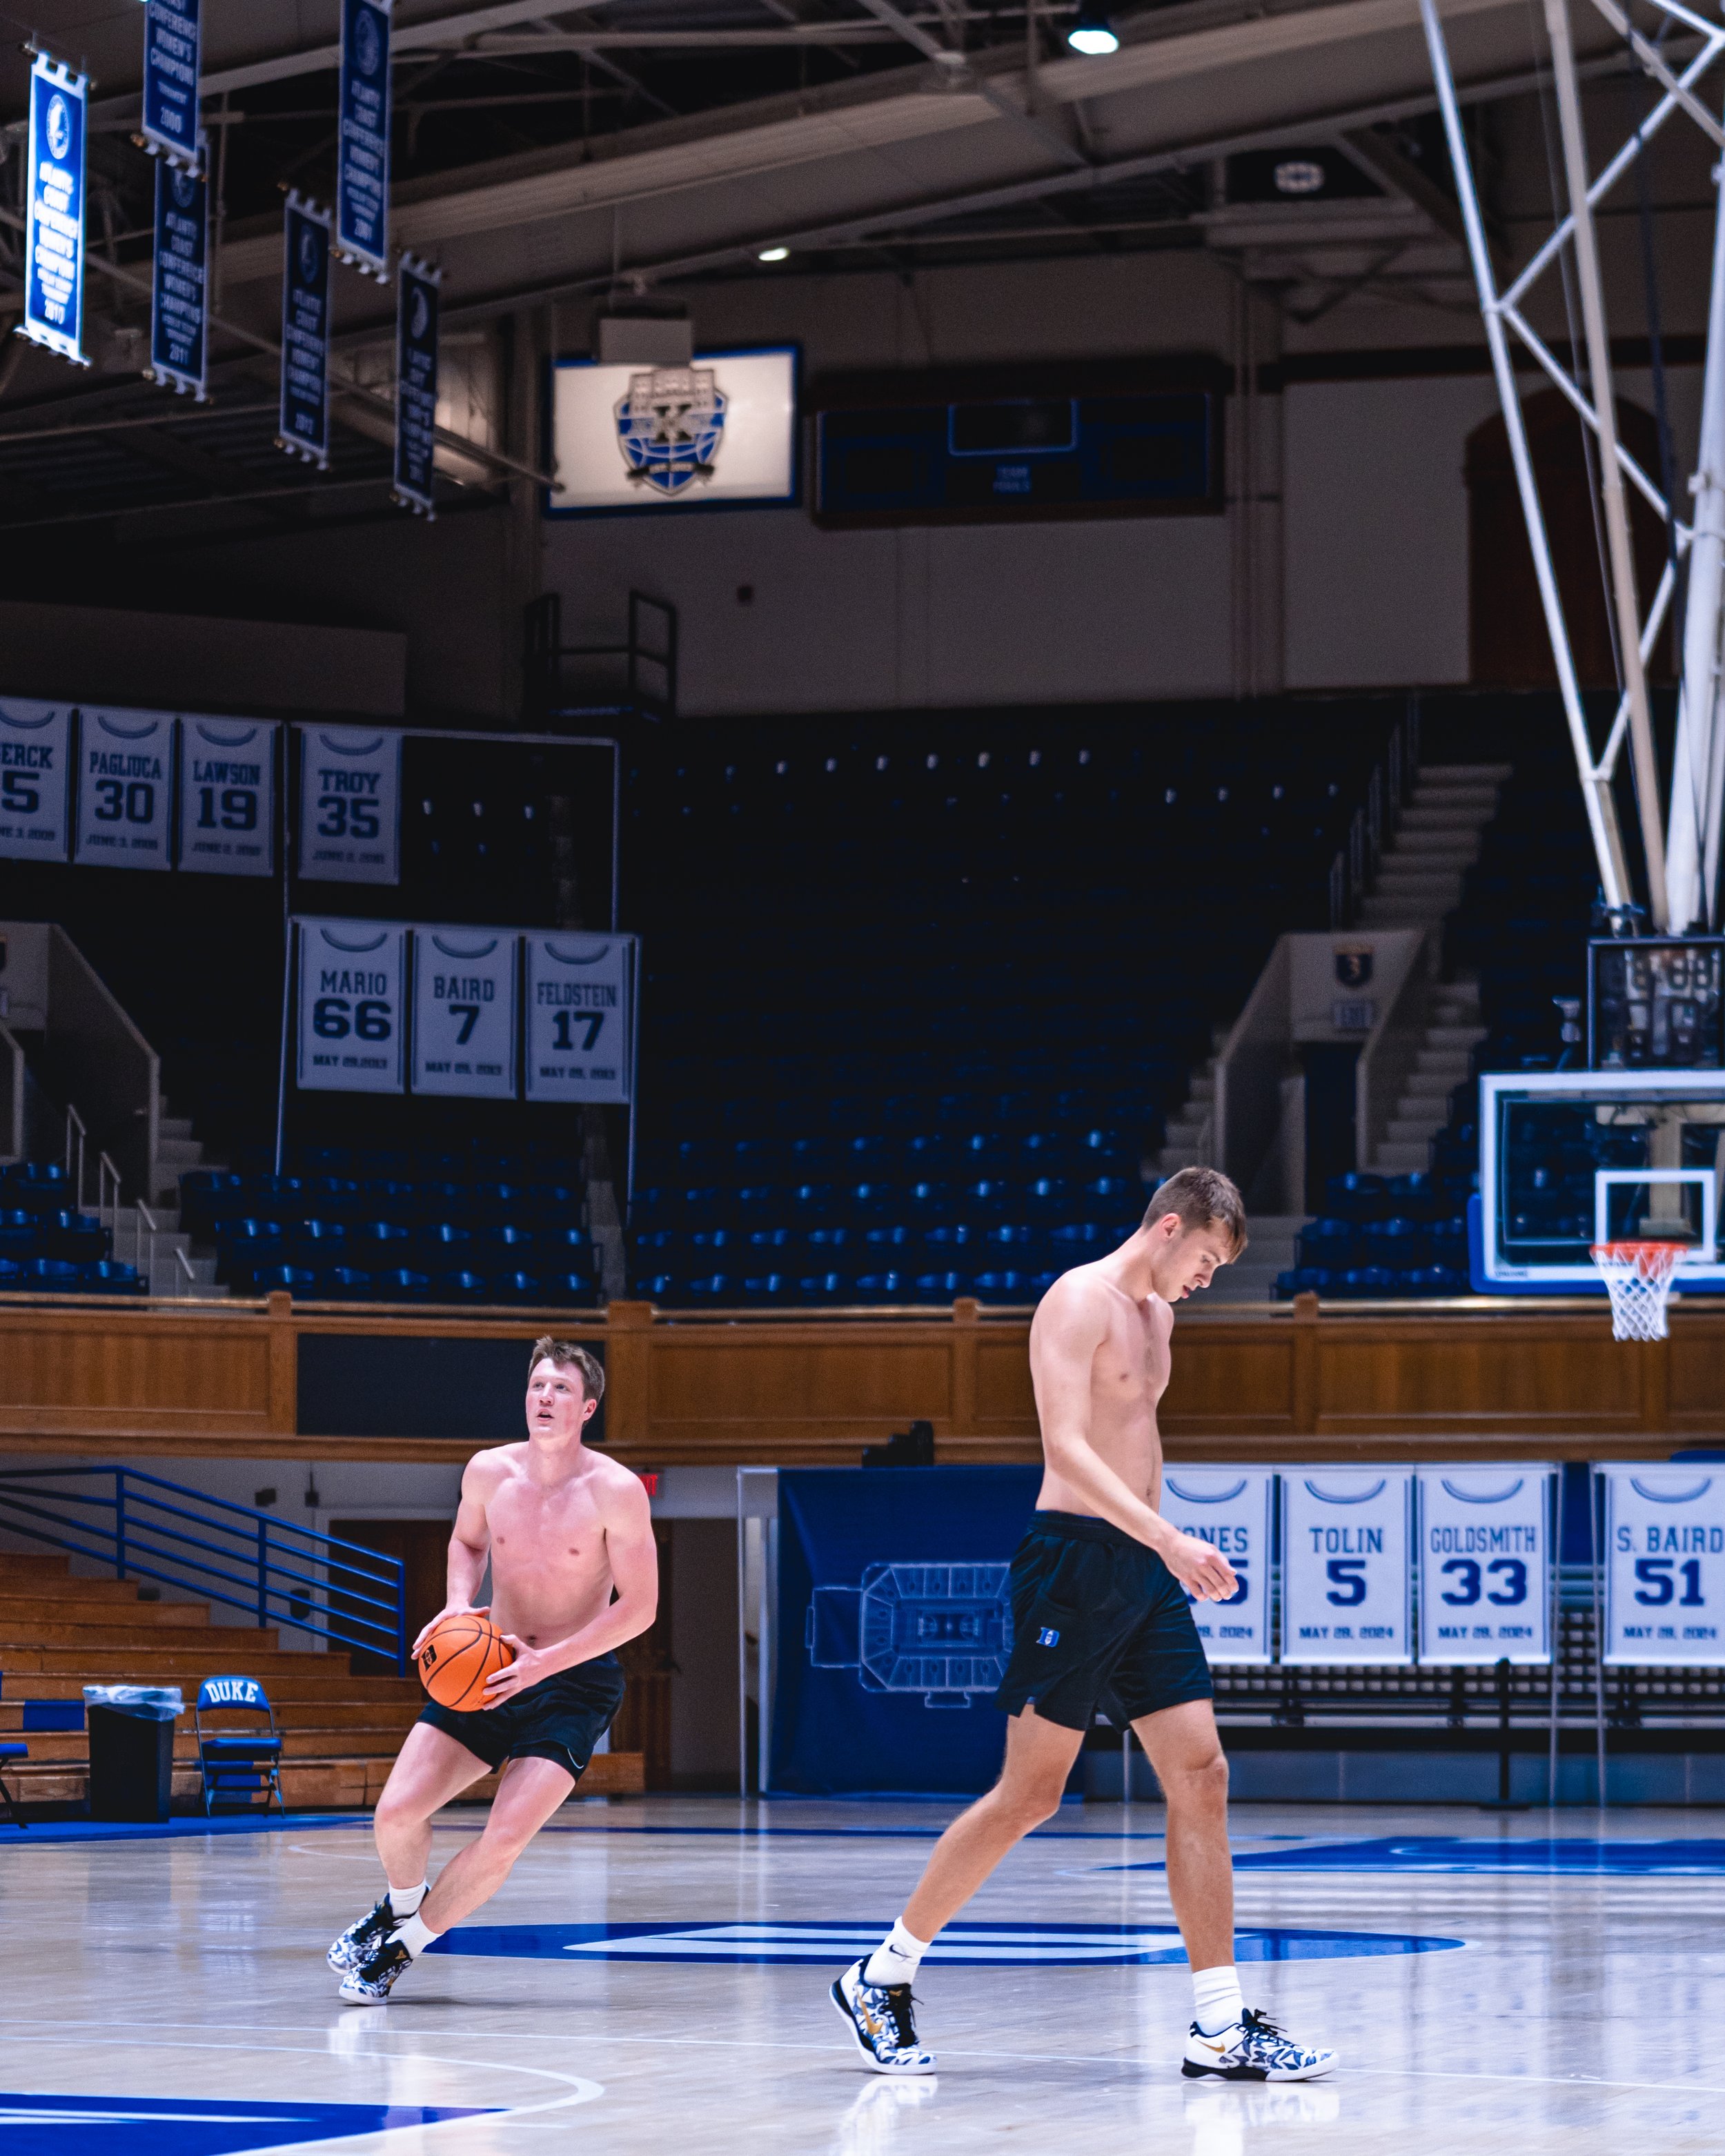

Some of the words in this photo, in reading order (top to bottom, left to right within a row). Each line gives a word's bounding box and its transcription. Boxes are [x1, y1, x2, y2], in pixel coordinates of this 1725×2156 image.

[0, 742, 53, 769] ERCK
[90, 751, 161, 779] PAGLIUCA
[194, 760, 260, 785] LAWSON
[319, 769, 380, 794] TROY
[1, 770, 39, 814] 5
[95, 780, 154, 824] 30
[197, 787, 257, 831] 19
[318, 796, 379, 839] 35
[321, 970, 387, 996] MARIO
[433, 976, 495, 1002] BAIRD
[538, 982, 617, 1007] FELDSTEIN
[314, 998, 391, 1041] 66
[448, 1005, 480, 1045] 7
[553, 1011, 604, 1051] 17
[313, 1055, 338, 1067] MAY
[426, 1062, 451, 1074] MAY
[540, 1066, 565, 1077] MAY
[641, 1474, 658, 1496] IT
[1176, 1526, 1248, 1553] NES
[1309, 1527, 1383, 1553] TOLIN
[1430, 1526, 1535, 1553] GOLDSMITH
[1617, 1526, 1637, 1552] S.
[1647, 1526, 1724, 1552] BAIRD
[1326, 1559, 1366, 1606] 5
[1441, 1559, 1528, 1605] 33
[1635, 1559, 1705, 1606] 51
[1299, 1627, 1328, 1639] MAY
[1438, 1627, 1467, 1639] MAY
[1623, 1627, 1652, 1639] MAY
[205, 1681, 259, 1703] DUKE
